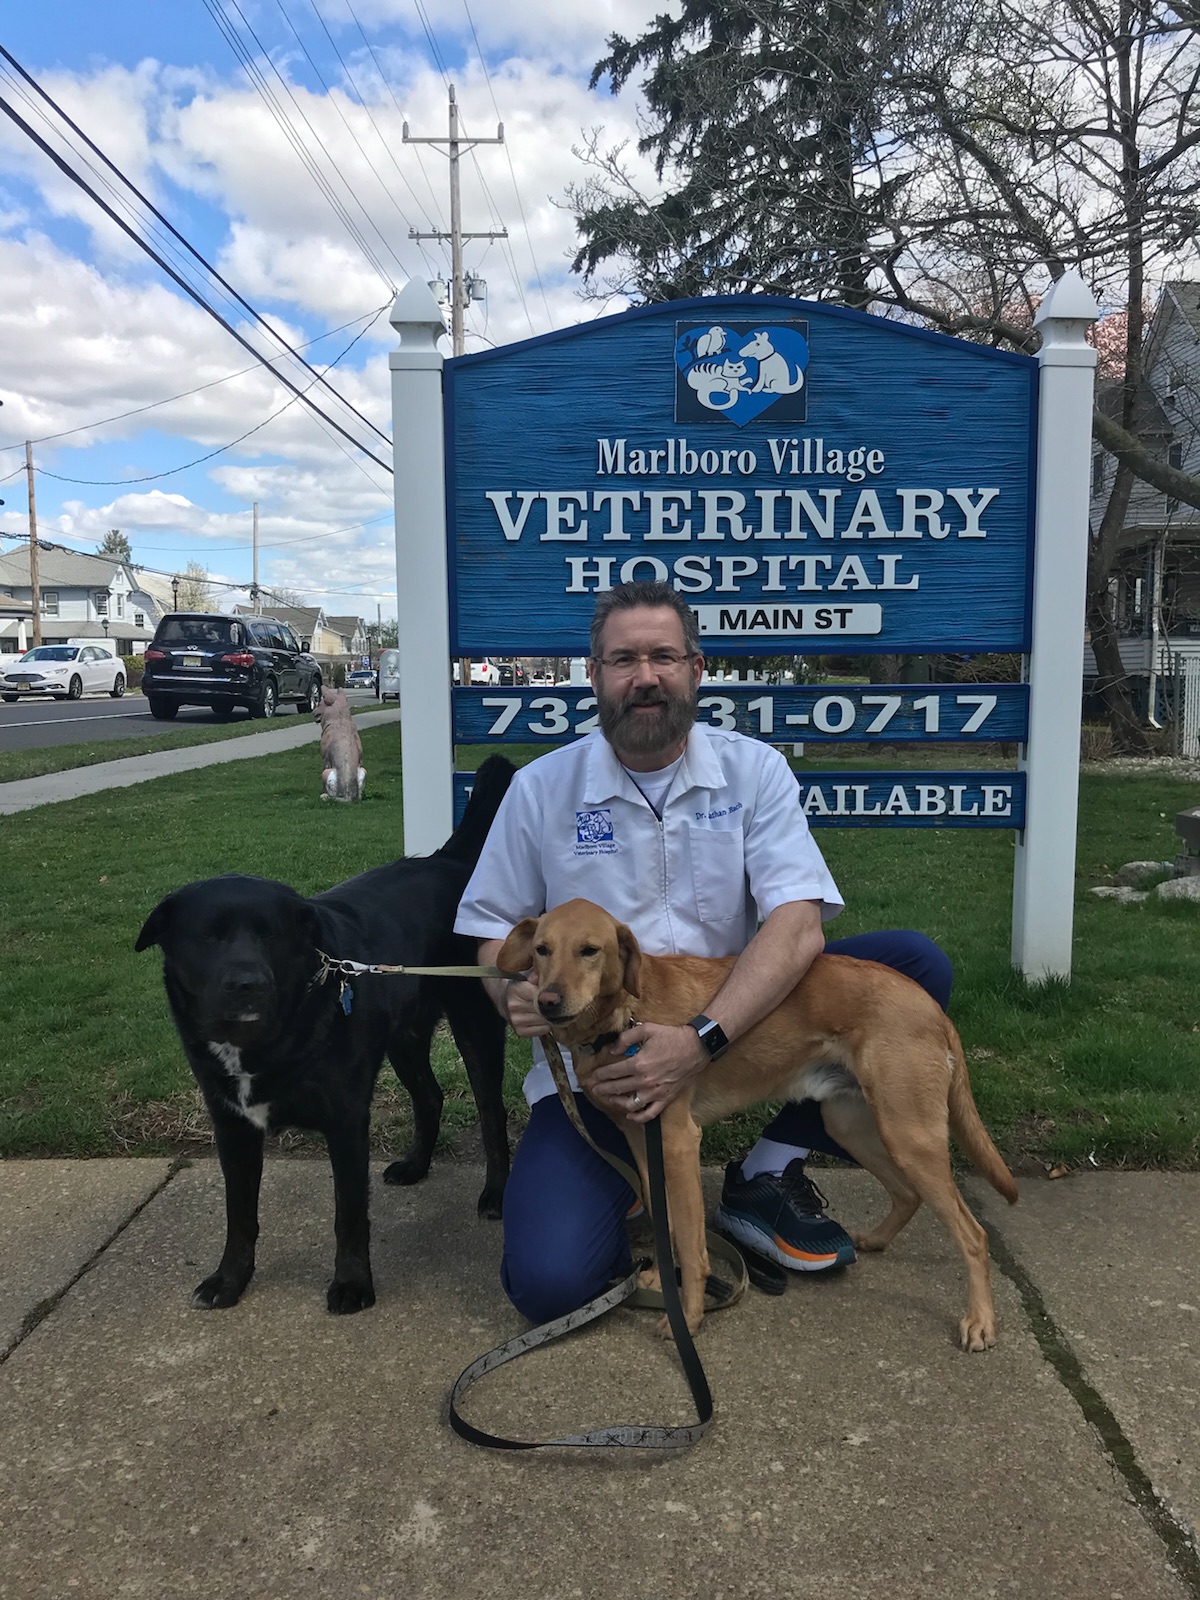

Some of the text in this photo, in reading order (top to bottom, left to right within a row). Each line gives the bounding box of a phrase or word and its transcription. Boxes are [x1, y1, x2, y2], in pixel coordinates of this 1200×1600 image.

[597, 438, 885, 482] Marlboro Village
[486, 488, 1000, 541] VETERINARY
[565, 555, 920, 592] HOSPITAL
[719, 609, 803, 630] MAIN
[814, 609, 853, 629] ST
[695, 812, 707, 820] Dr.
[800, 785, 1012, 816] AILABLE
